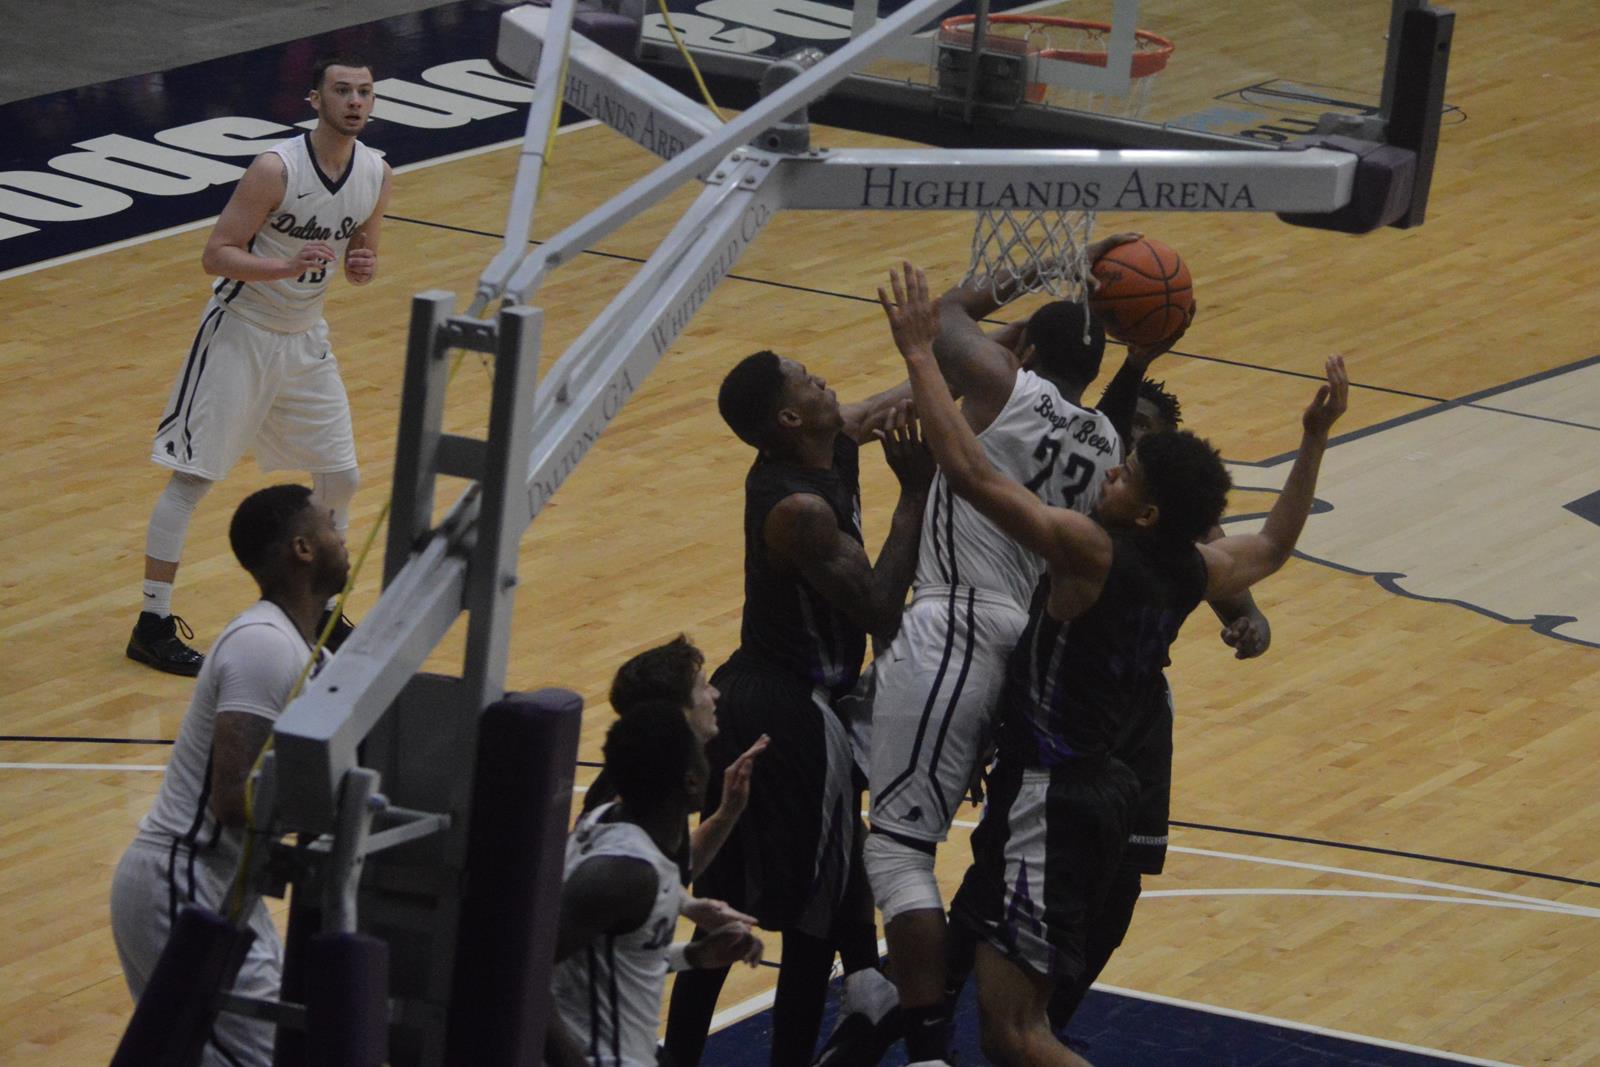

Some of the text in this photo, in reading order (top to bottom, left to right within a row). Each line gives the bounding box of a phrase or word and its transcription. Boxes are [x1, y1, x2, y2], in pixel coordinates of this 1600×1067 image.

[567, 76, 636, 136] HLANDS
[861, 167, 1256, 208] HIGHLANDS ARENA
[271, 213, 332, 240] Dalton
[603, 368, 635, 421] GA
[651, 242, 739, 353] WHITFIELD
